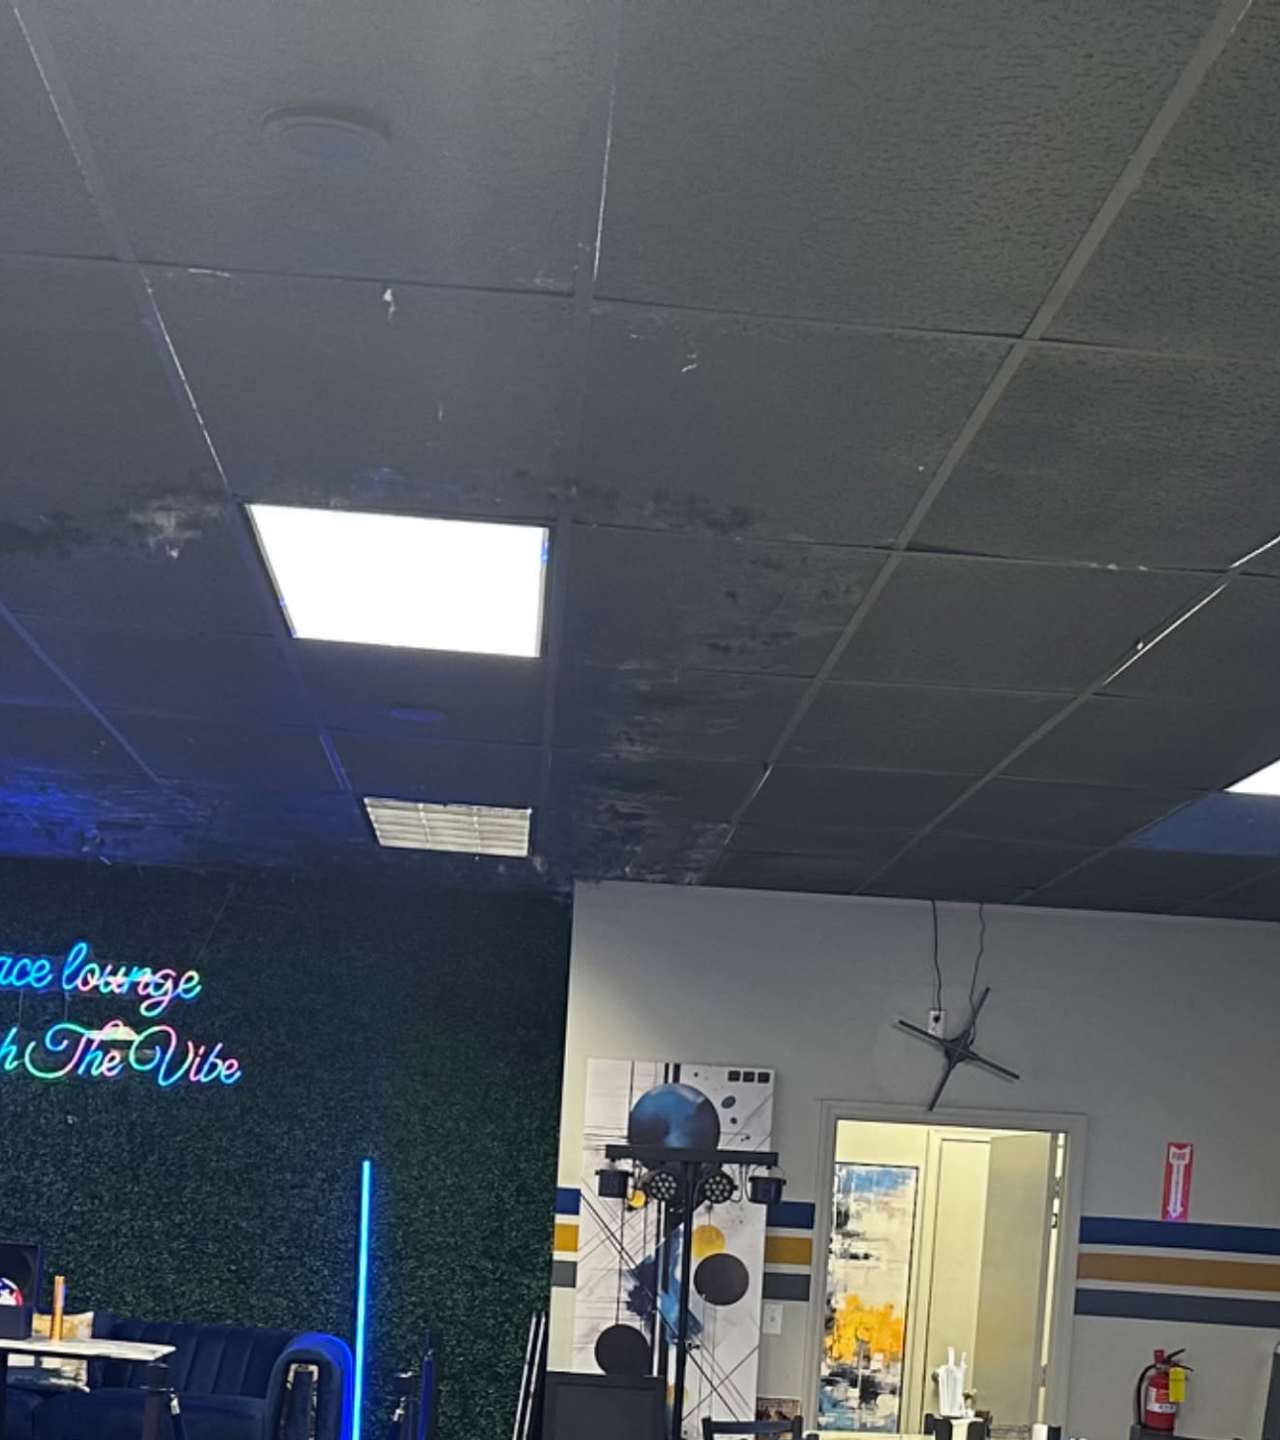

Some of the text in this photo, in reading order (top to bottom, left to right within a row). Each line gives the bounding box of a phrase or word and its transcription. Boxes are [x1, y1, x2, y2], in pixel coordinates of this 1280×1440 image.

[62, 943, 201, 1017] lounge
[25, 1020, 125, 1079] The
[128, 1026, 242, 1088] Vibe
